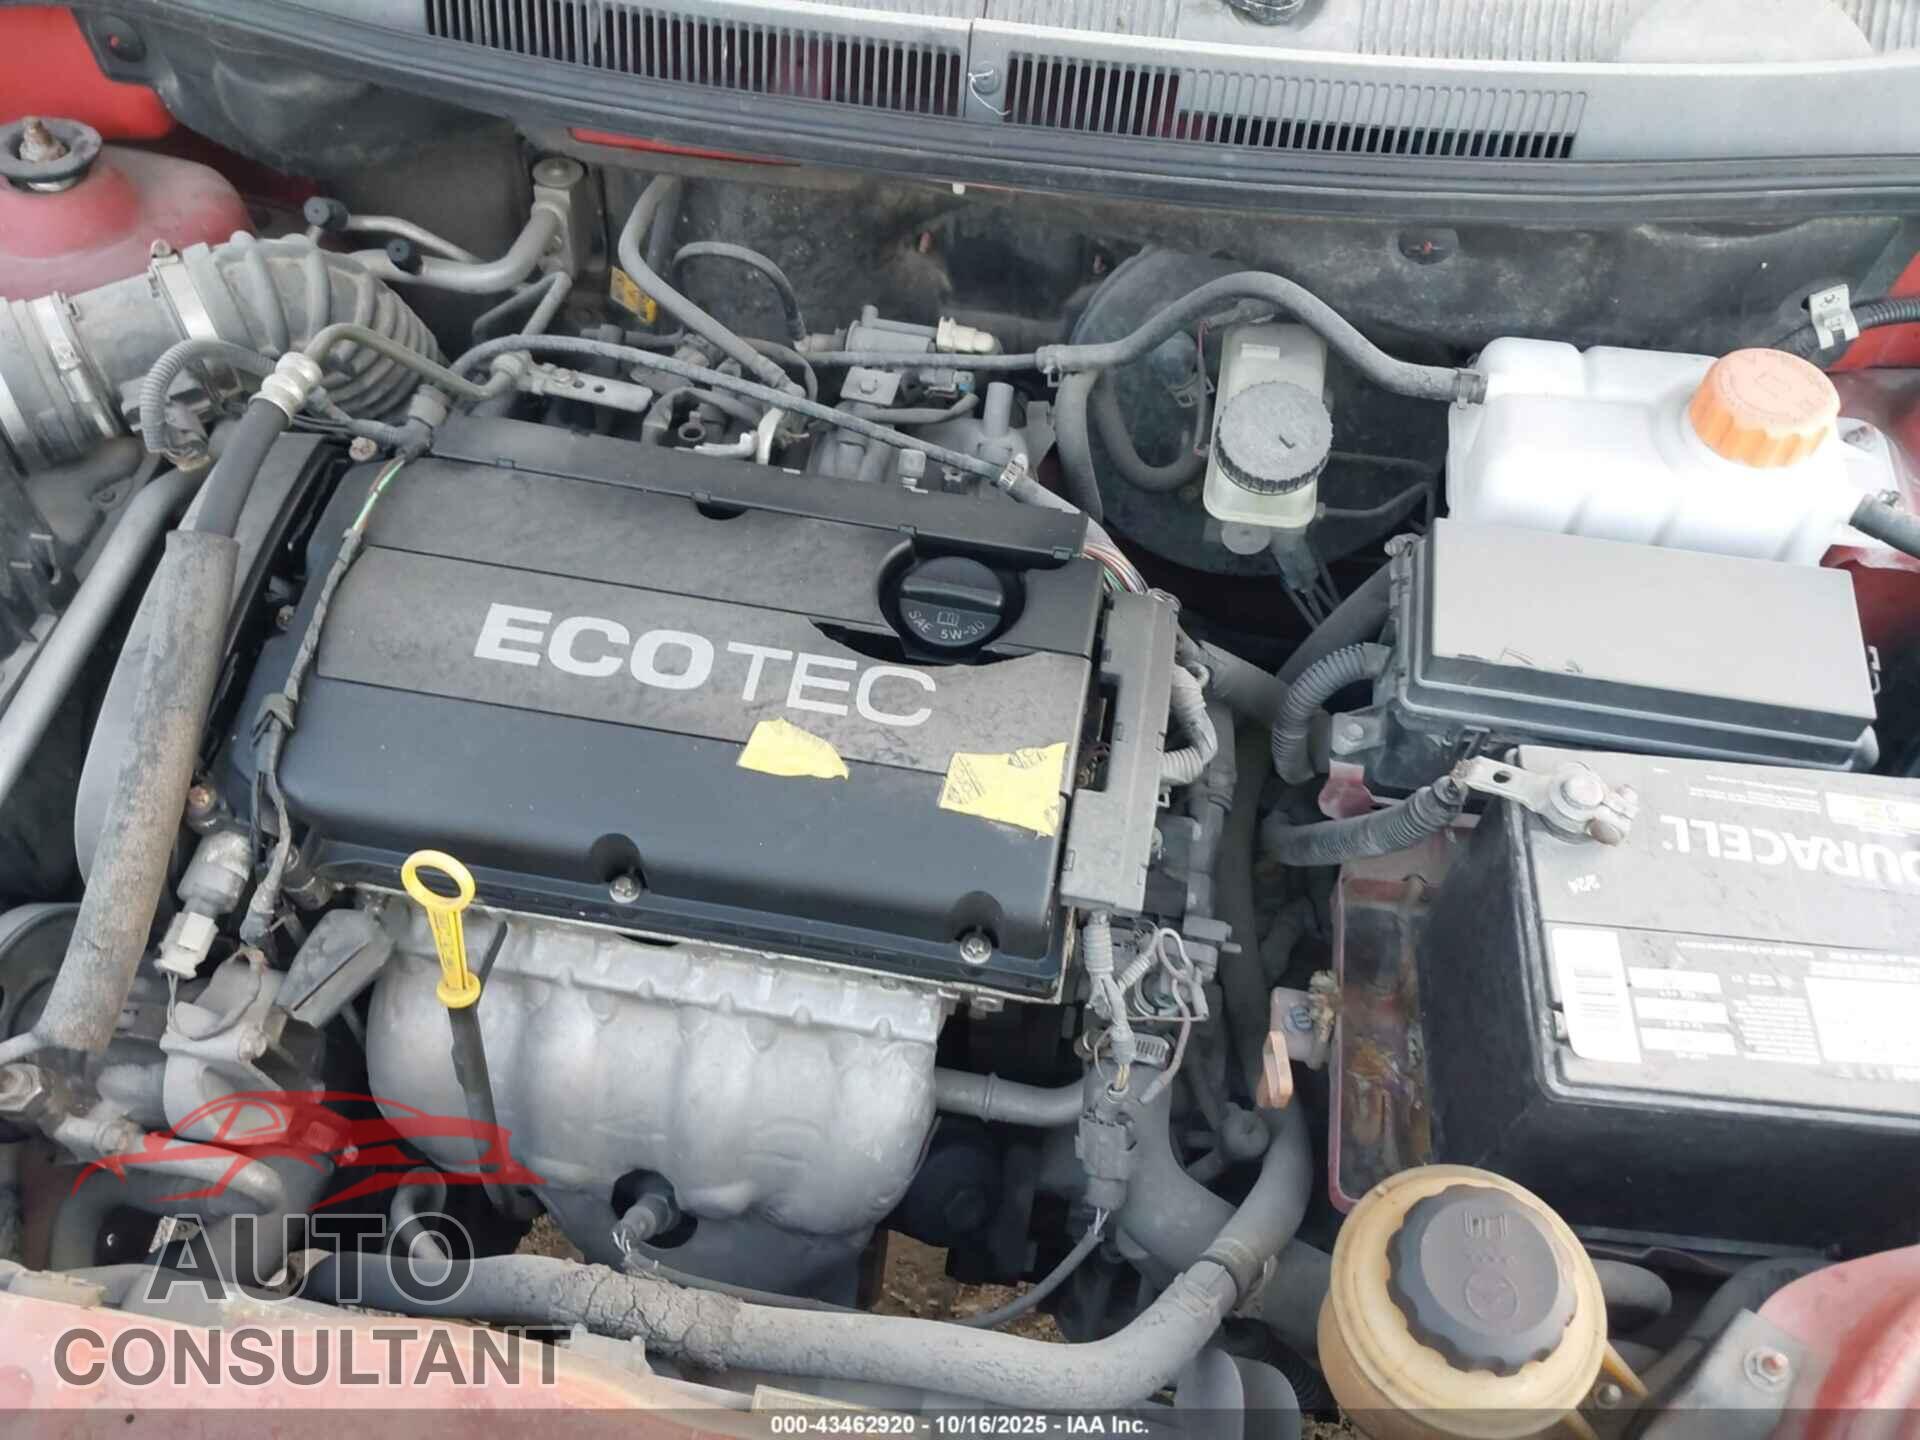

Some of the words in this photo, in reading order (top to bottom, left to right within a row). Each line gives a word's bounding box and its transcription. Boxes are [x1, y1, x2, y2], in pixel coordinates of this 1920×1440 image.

[473, 602, 937, 727] ECOTEC
[908, 610, 935, 634] SAE
[939, 619, 986, 641] 5W-30
